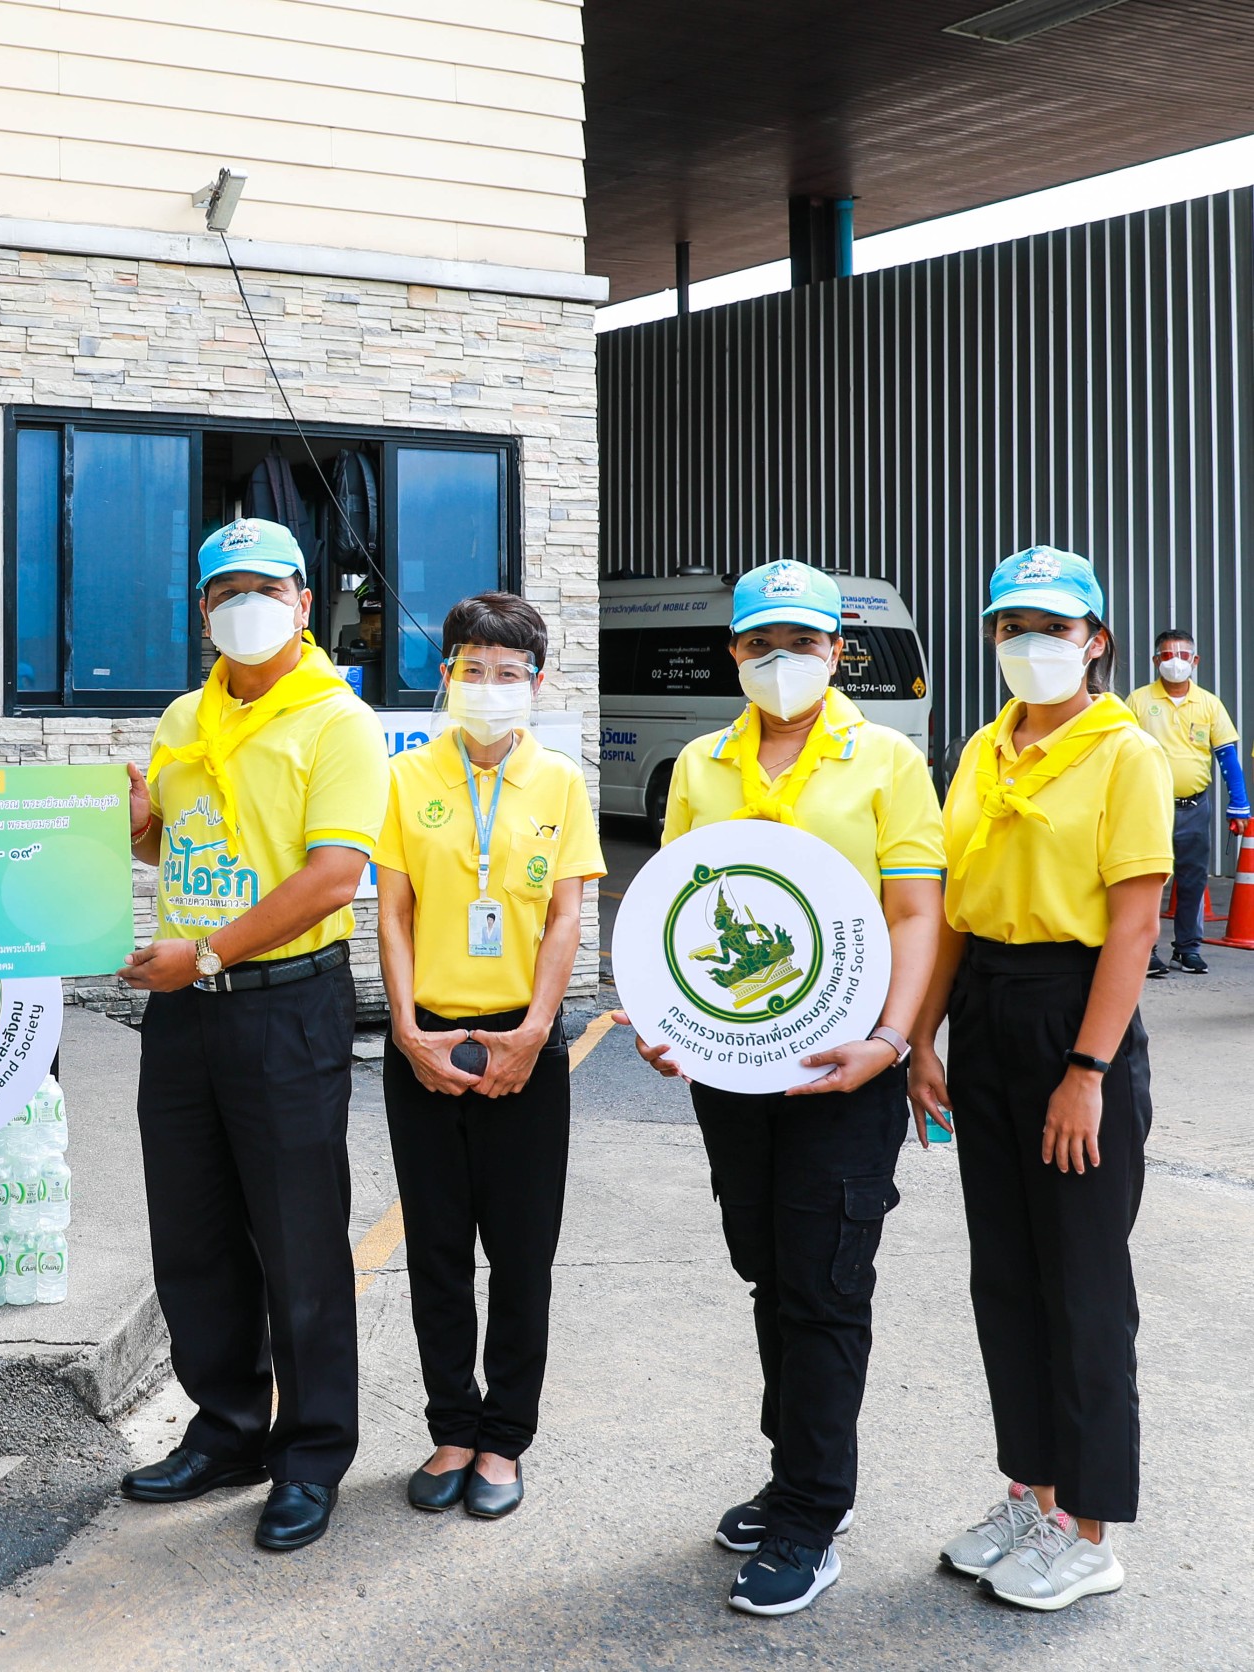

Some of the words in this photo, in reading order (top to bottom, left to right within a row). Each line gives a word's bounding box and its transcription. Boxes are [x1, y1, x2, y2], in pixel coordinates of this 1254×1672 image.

[663, 602, 689, 611] MOBILE
[692, 602, 708, 610] CCU
[847, 684, 896, 692] 02-574-1000
[601, 750, 635, 761] OSPITAL
[850, 917, 865, 974] Society
[668, 920, 847, 1047] กระทรวงดิจิทัลเพื่อเศรษฐกิจและสังคม
[842, 977, 860, 1005] and
[14, 1003, 44, 1060] Society
[658, 1018, 714, 1062] Ministry
[792, 1008, 848, 1055] Economy
[717, 1051, 736, 1064] of
[738, 1045, 788, 1067] Digital
[41, 1263, 61, 1271] Chang
